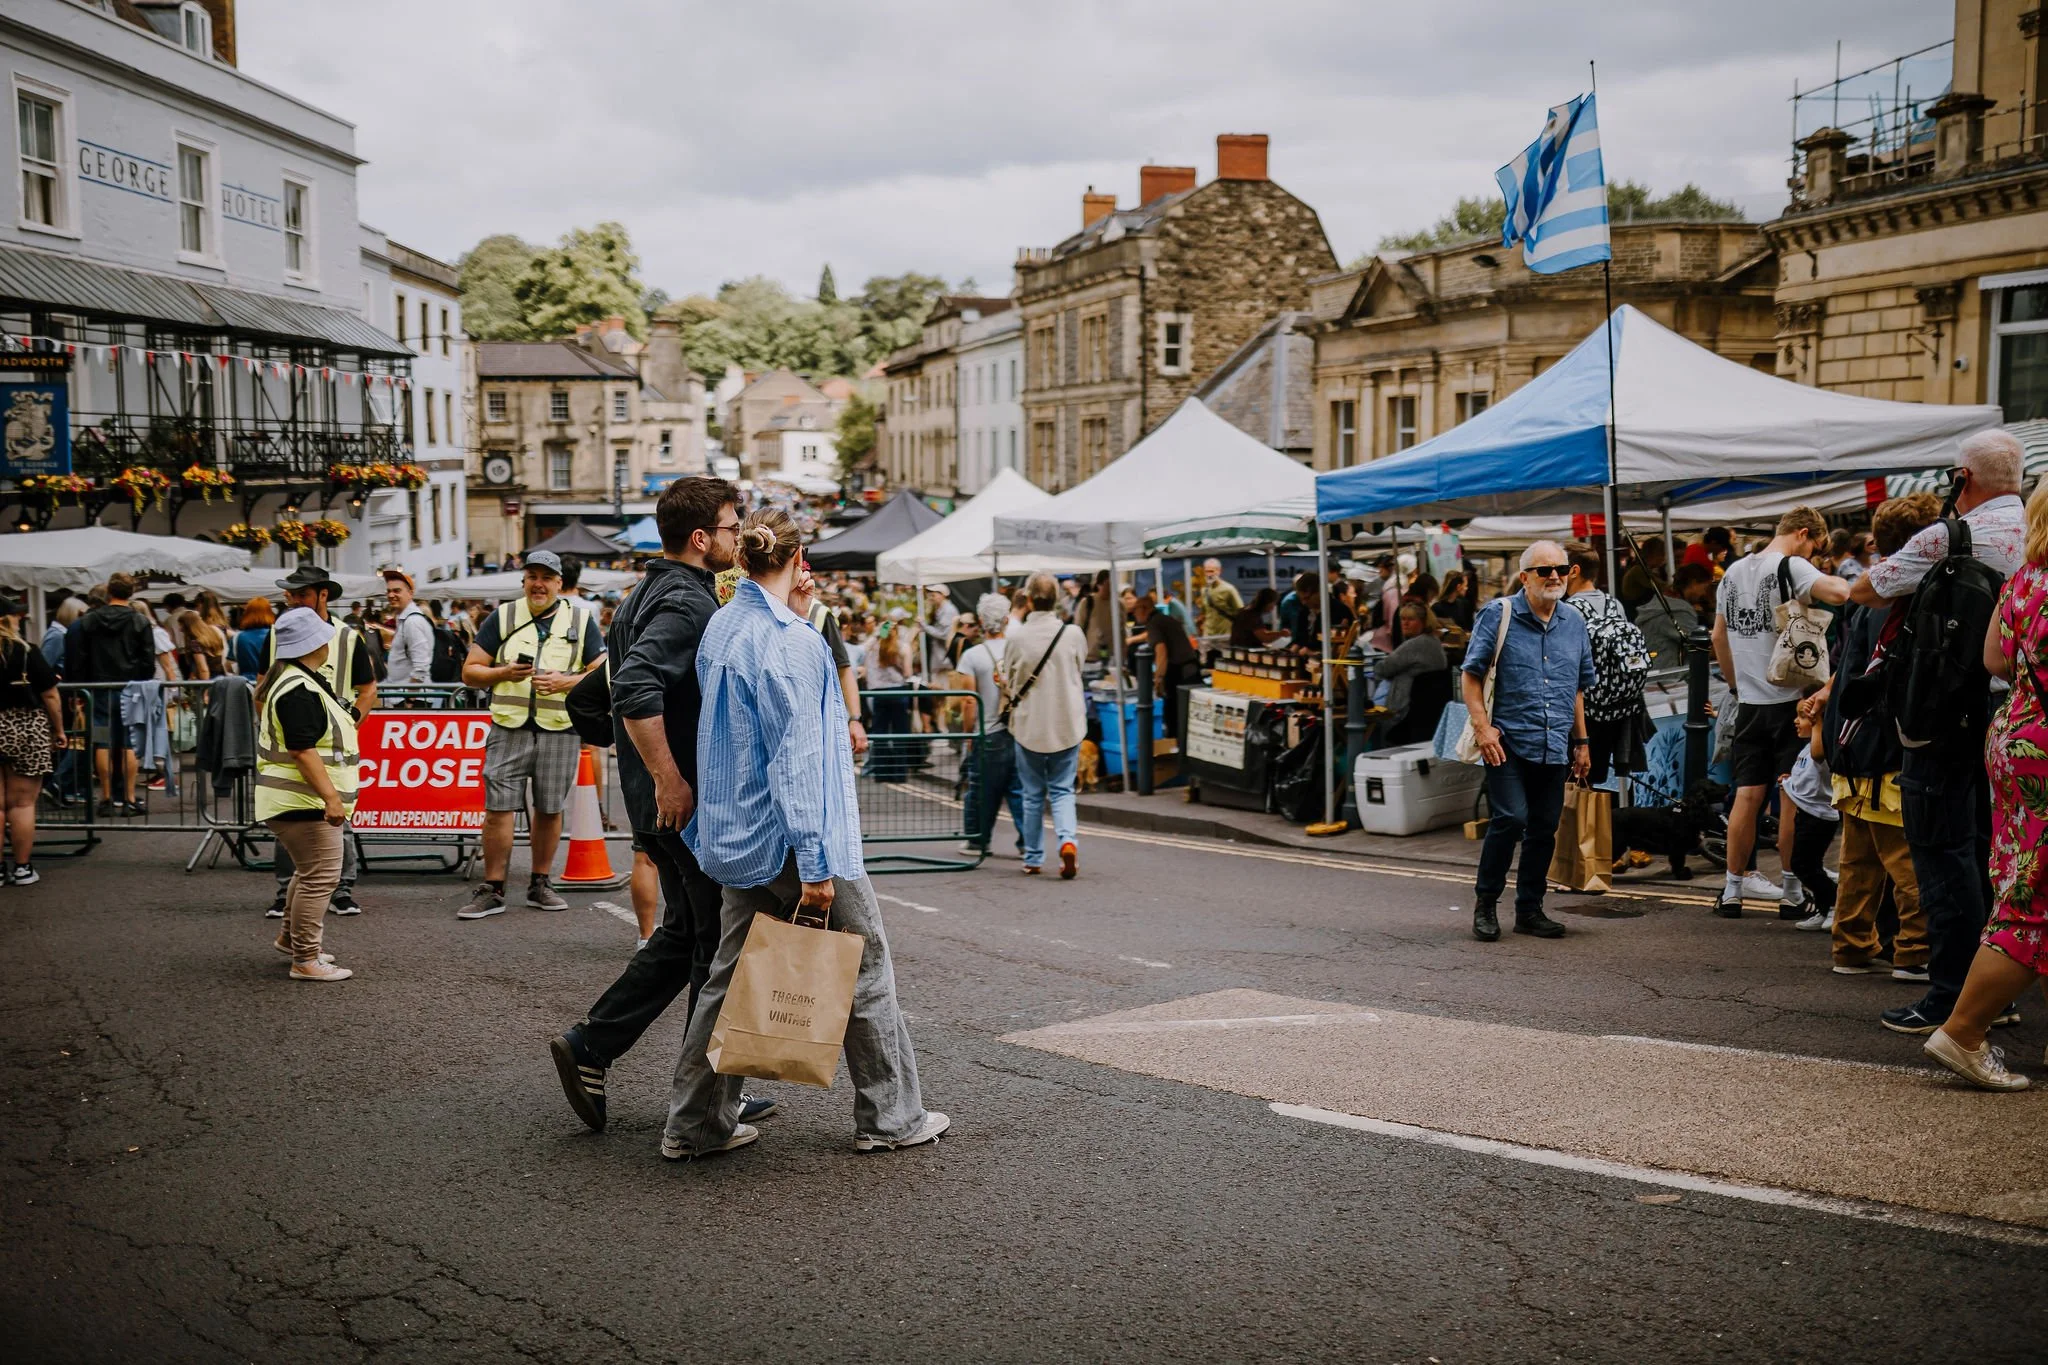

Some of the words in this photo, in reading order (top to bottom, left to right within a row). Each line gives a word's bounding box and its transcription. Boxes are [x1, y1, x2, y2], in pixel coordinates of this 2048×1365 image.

[79, 146, 170, 197] GEORGE
[222, 188, 279, 227] HOTEL
[0, 357, 65, 367] ADWORTH
[382, 721, 491, 749] ROAD
[358, 759, 482, 788] CLOSE
[353, 810, 379, 826] OME
[380, 810, 460, 827] INDEPENDENT
[460, 811, 487, 827] MAR
[769, 1010, 812, 1027] VINTAGE
